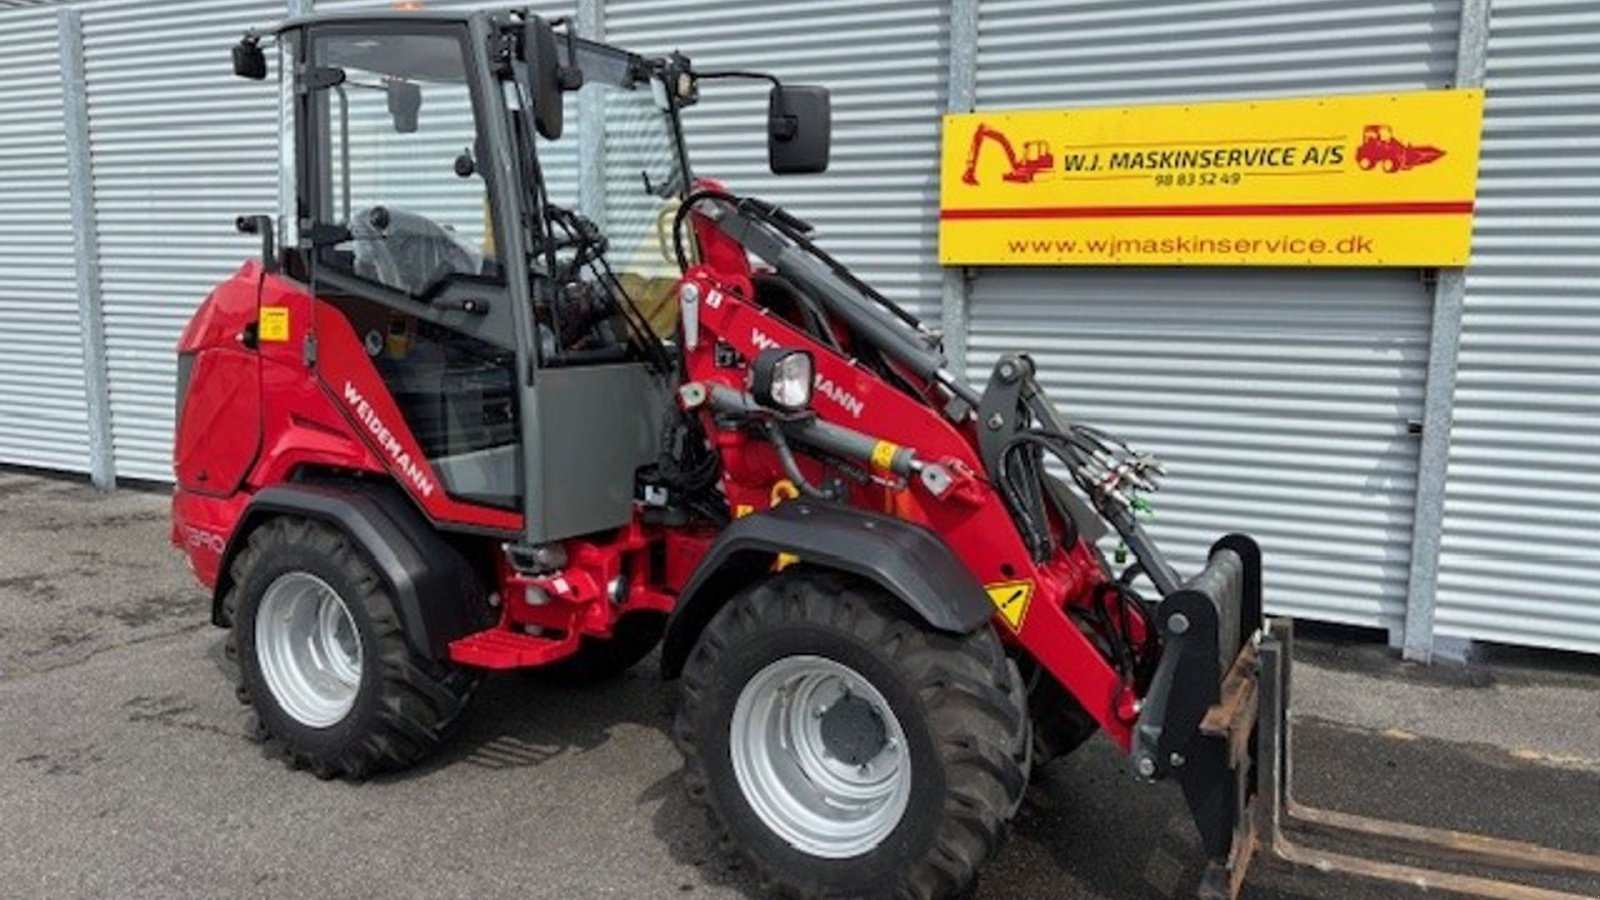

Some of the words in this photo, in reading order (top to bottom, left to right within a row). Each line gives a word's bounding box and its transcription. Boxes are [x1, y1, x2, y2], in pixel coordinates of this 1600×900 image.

[1063, 154, 1103, 171] W.J.
[1109, 147, 1296, 170] MASKINSERVICE
[1302, 145, 1345, 165] A/S
[1154, 174, 1173, 187] 98
[1177, 173, 1196, 186] 83
[1199, 172, 1217, 185] 52
[1220, 172, 1241, 185] 49
[1007, 234, 1375, 257] www.wjmaskinservice.dk
[345, 381, 434, 496] WEIDEMANN
